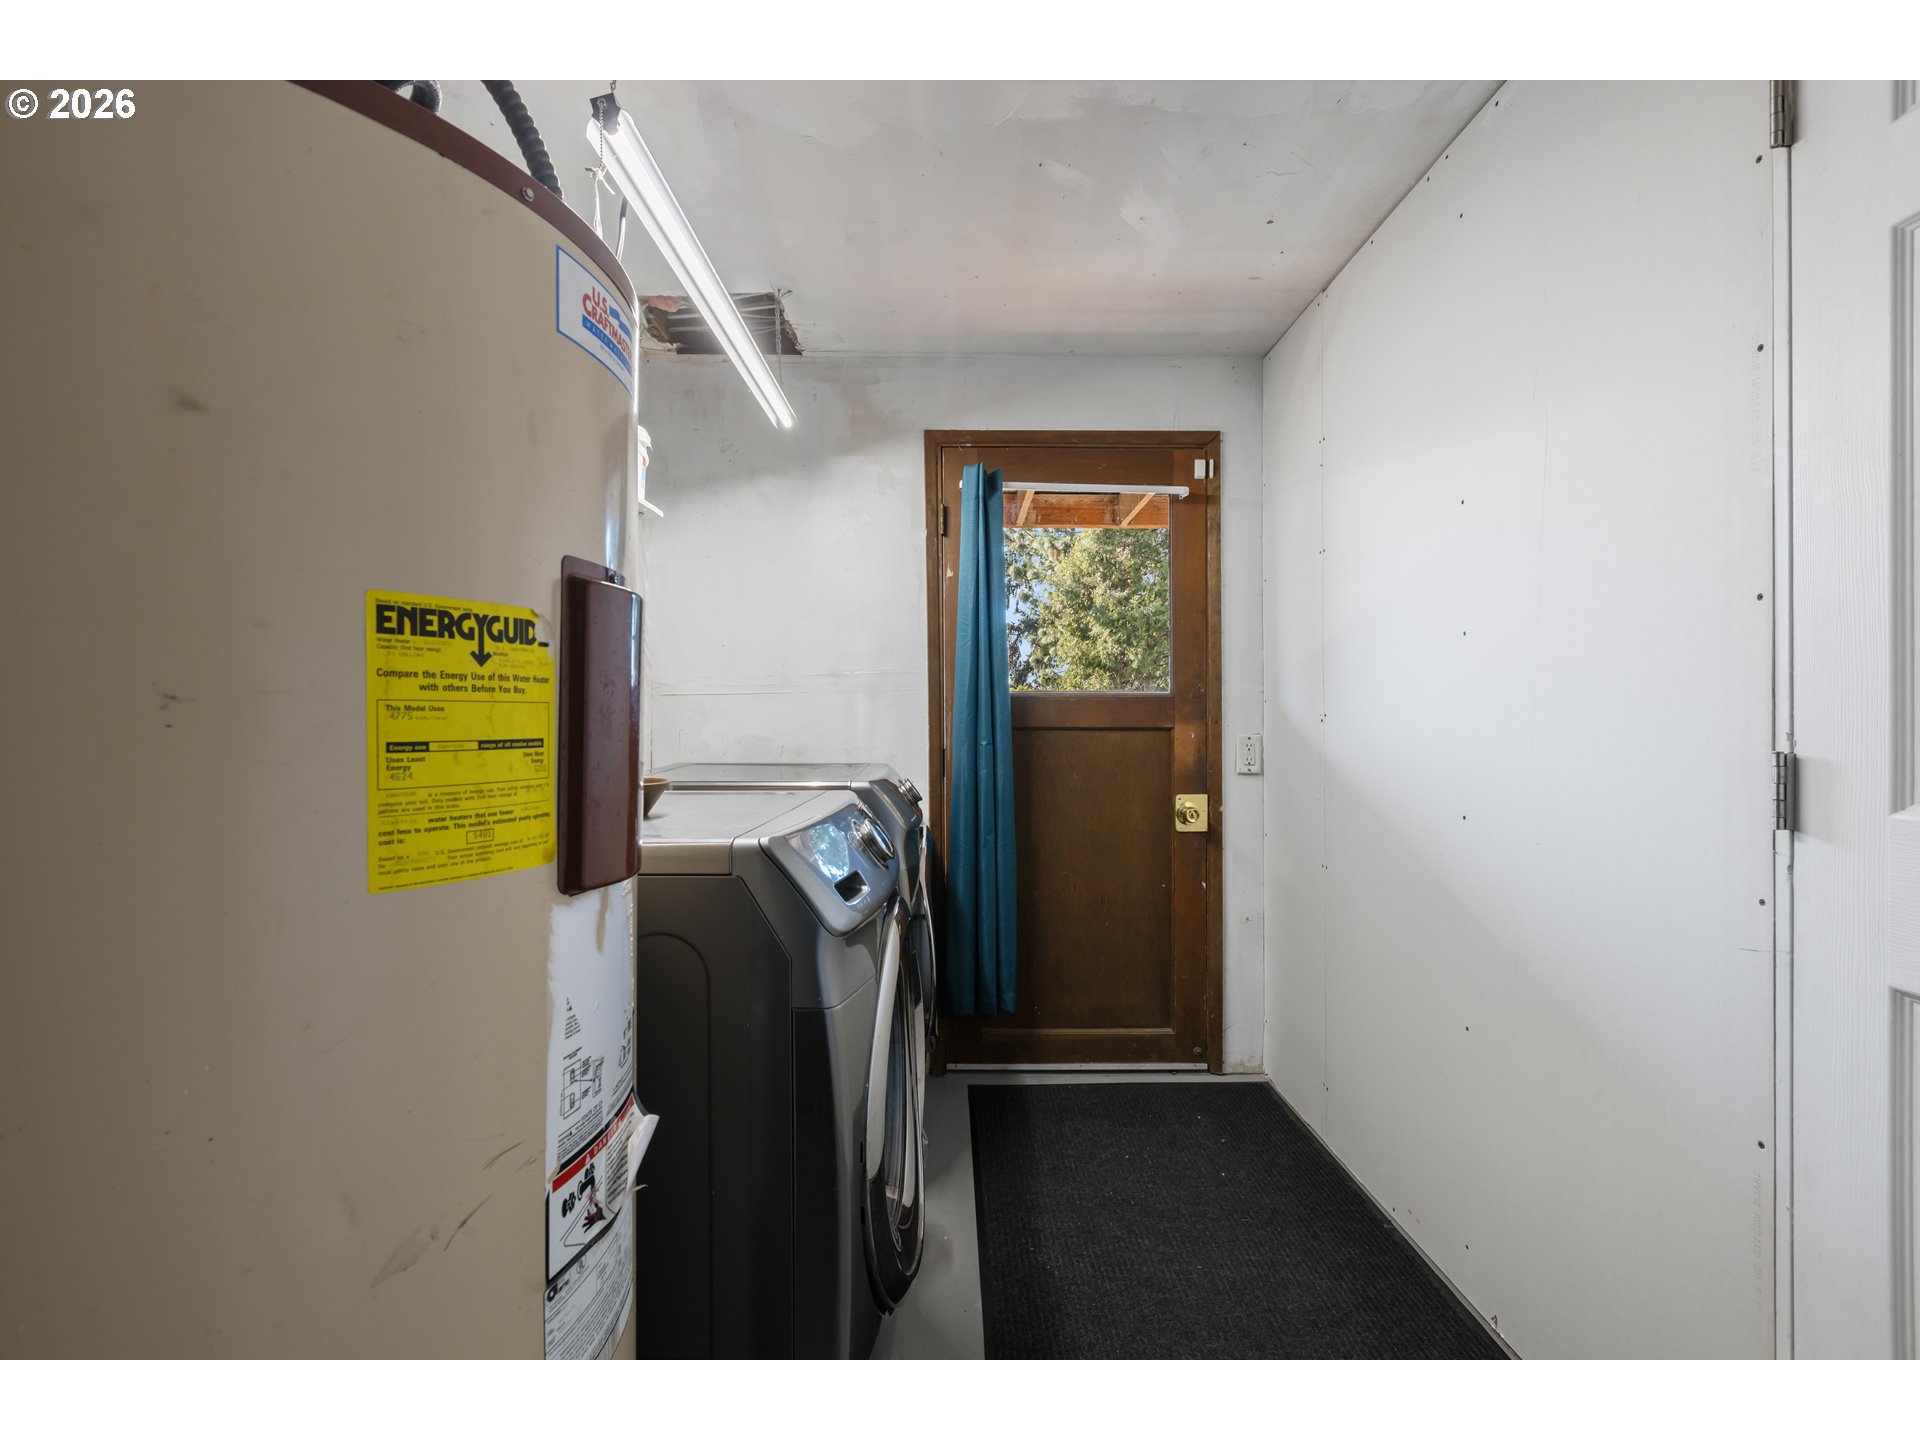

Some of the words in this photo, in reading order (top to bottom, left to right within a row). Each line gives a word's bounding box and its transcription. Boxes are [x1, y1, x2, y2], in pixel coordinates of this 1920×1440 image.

[592, 285, 610, 318] U.S.
[376, 604, 550, 648] ENERGYGUID
[376, 667, 419, 680] Compare
[422, 669, 437, 679] the
[439, 670, 468, 682] Energy
[470, 671, 486, 681] Use
[487, 672, 496, 681] of
[497, 673, 510, 682] this
[512, 673, 530, 683] Water
[532, 675, 550, 684] Heater
[418, 683, 438, 692] with
[442, 683, 468, 693] others
[471, 684, 496, 693] Before
[498, 684, 511, 694] You
[513, 685, 528, 696] Buy.
[385, 704, 401, 712] This
[404, 704, 426, 712] Model
[428, 704, 445, 712] Uses
[388, 744, 413, 752] Energy
[385, 756, 404, 764] Uses
[385, 764, 411, 772] Energy
[423, 825, 450, 834] operate.
[492, 816, 517, 824] estimated
